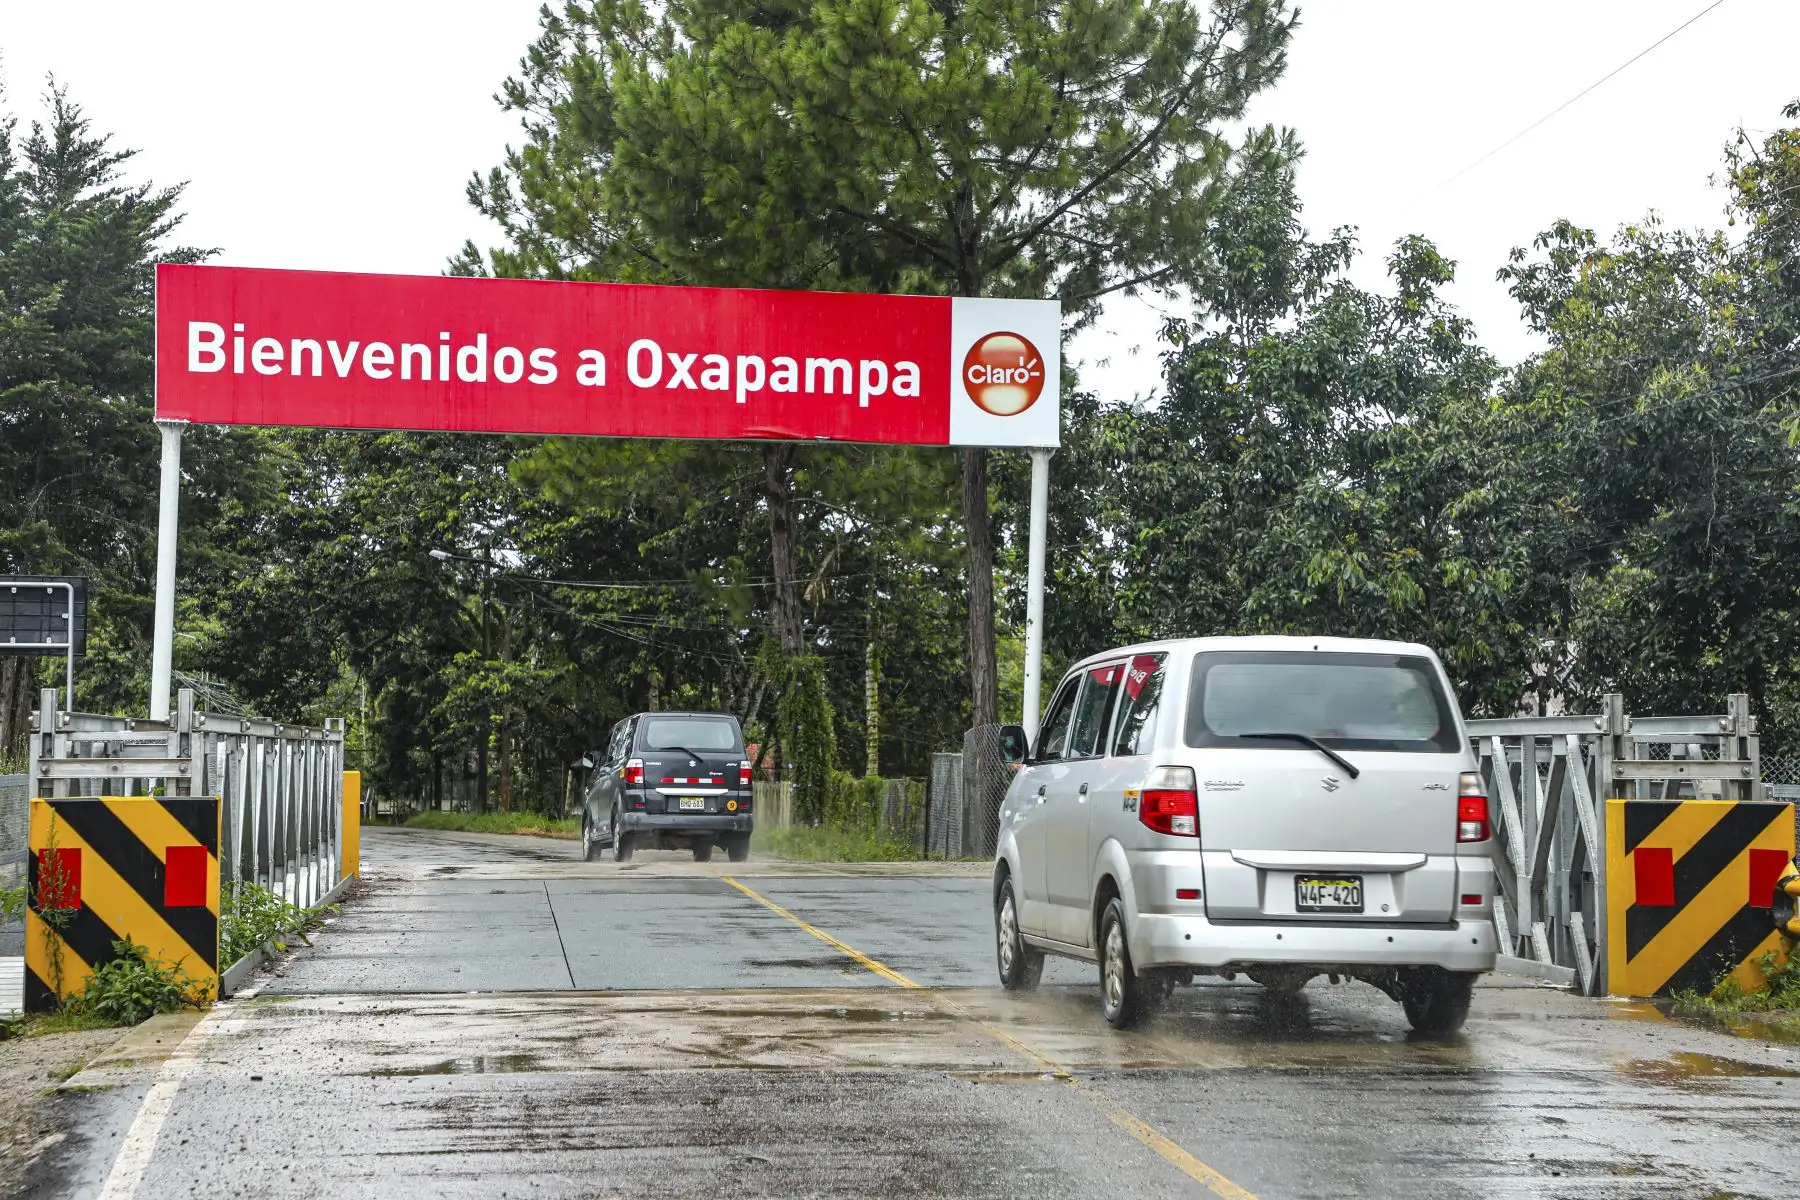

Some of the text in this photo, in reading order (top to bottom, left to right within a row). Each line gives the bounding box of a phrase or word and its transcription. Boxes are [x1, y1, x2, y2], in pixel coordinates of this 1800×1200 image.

[188, 321, 921, 408] Bienvenidos a Oxapampa
[968, 364, 1030, 384] Claro
[1300, 885, 1360, 905] W4F-420
